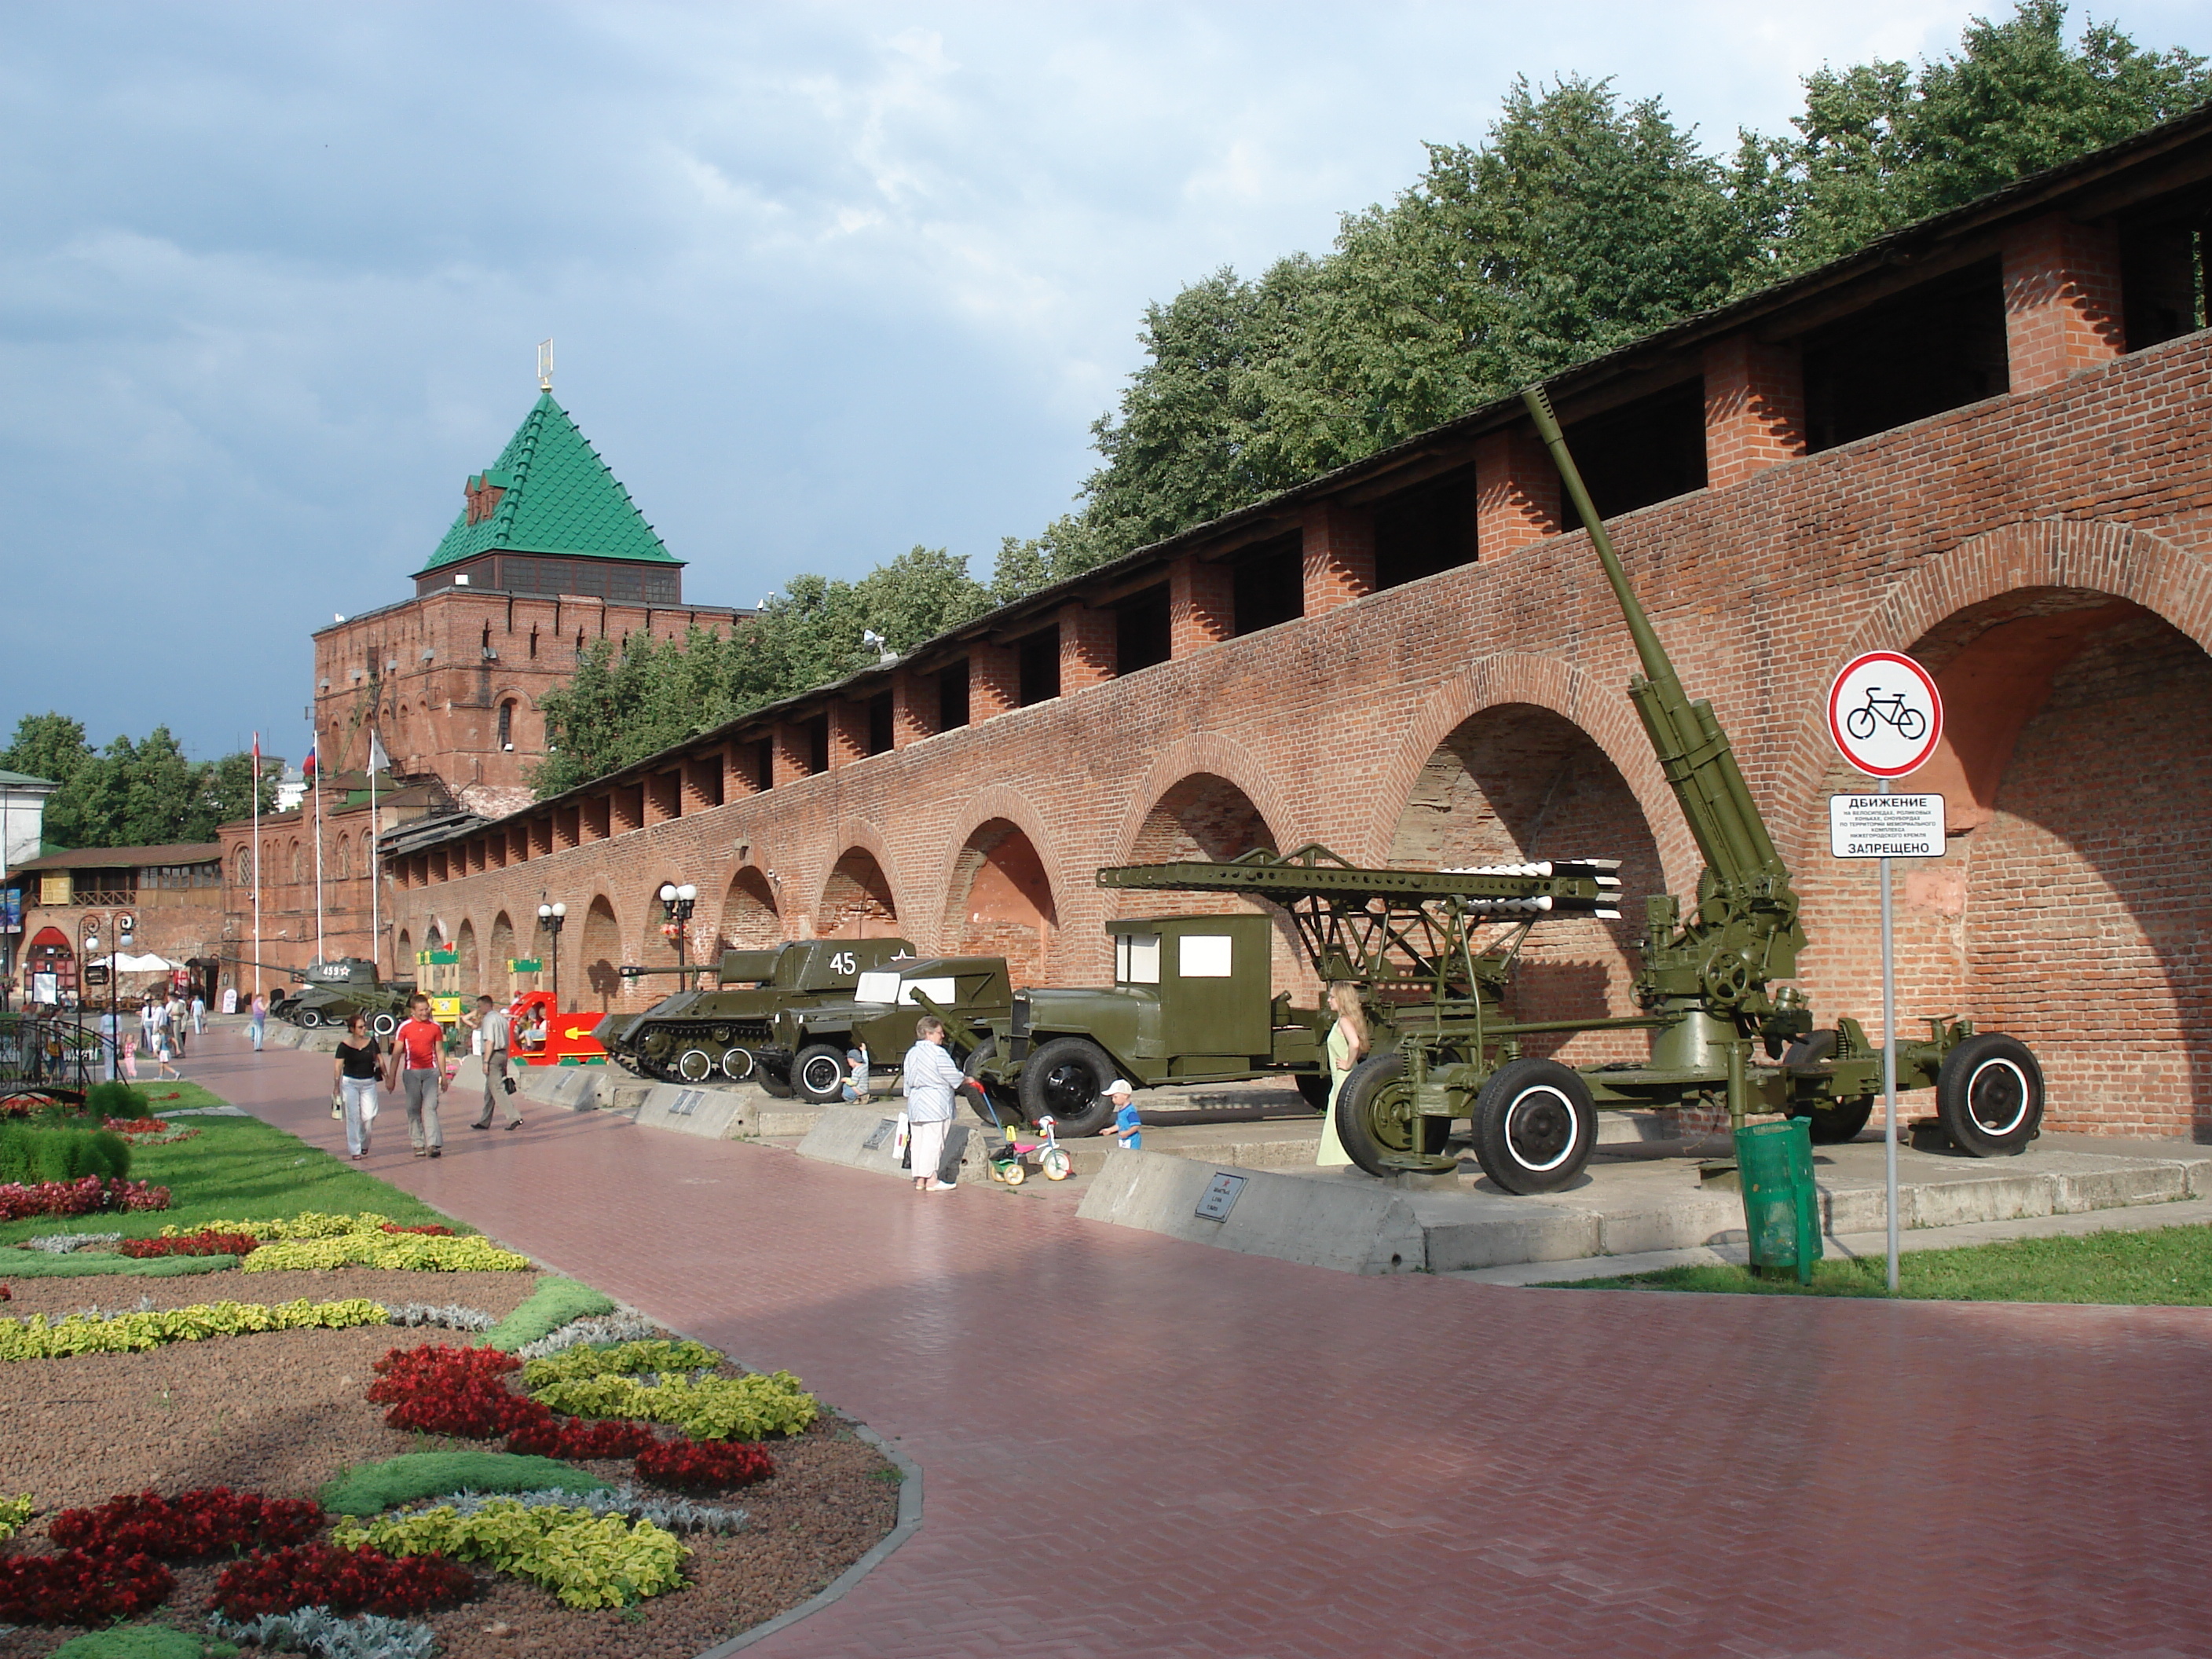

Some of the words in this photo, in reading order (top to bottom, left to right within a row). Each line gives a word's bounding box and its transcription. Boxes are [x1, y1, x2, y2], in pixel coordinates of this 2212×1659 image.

[1848, 843, 1929, 855] ЗАПРЕЩЕНО
[830, 952, 856, 975] 45
[323, 966, 339, 976] 459
